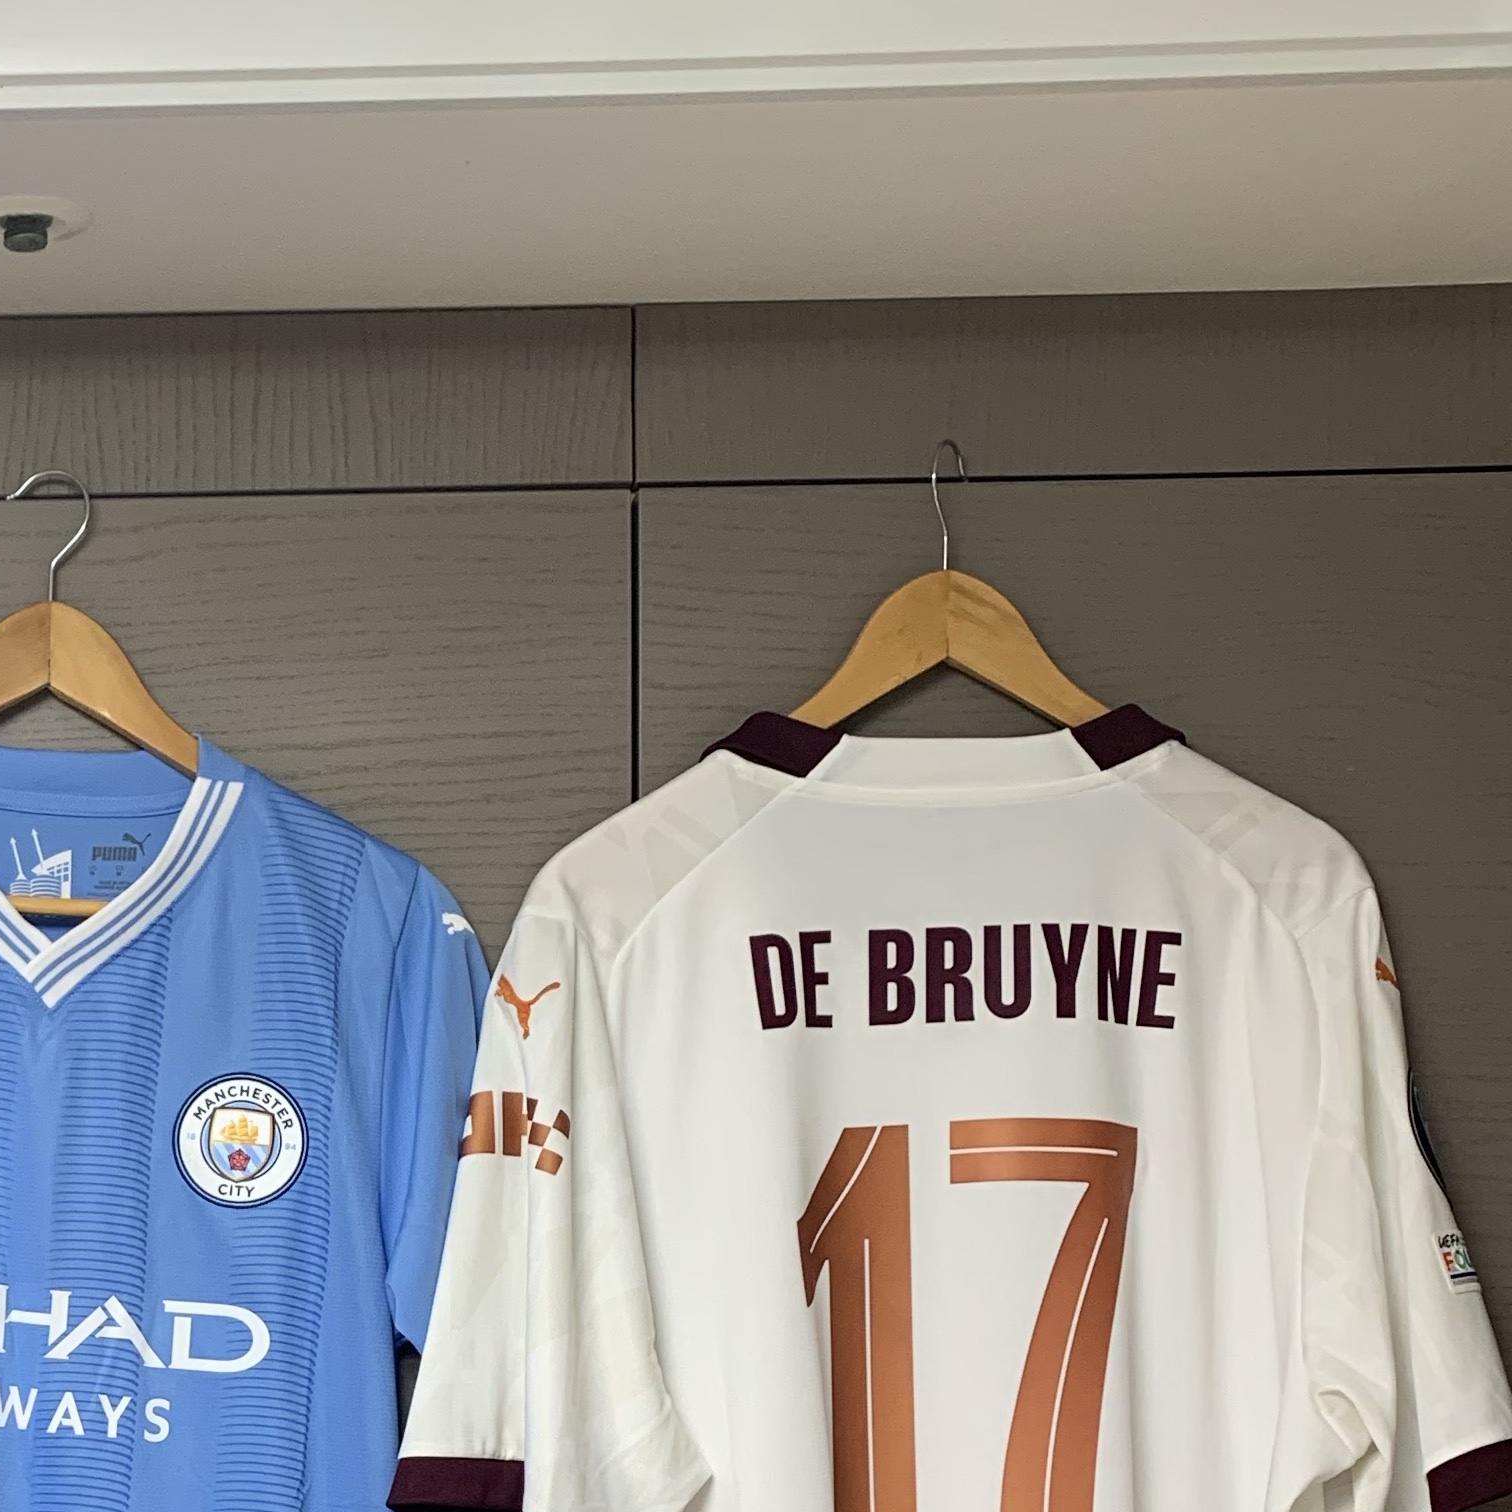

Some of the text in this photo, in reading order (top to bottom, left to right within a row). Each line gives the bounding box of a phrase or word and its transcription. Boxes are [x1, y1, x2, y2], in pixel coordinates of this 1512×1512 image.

[92, 846, 137, 862] PUMA
[749, 923, 1182, 1030] DE BRUYNE
[193, 1085, 294, 1130] MANCHESTER
[218, 1184, 255, 1197] CITY
